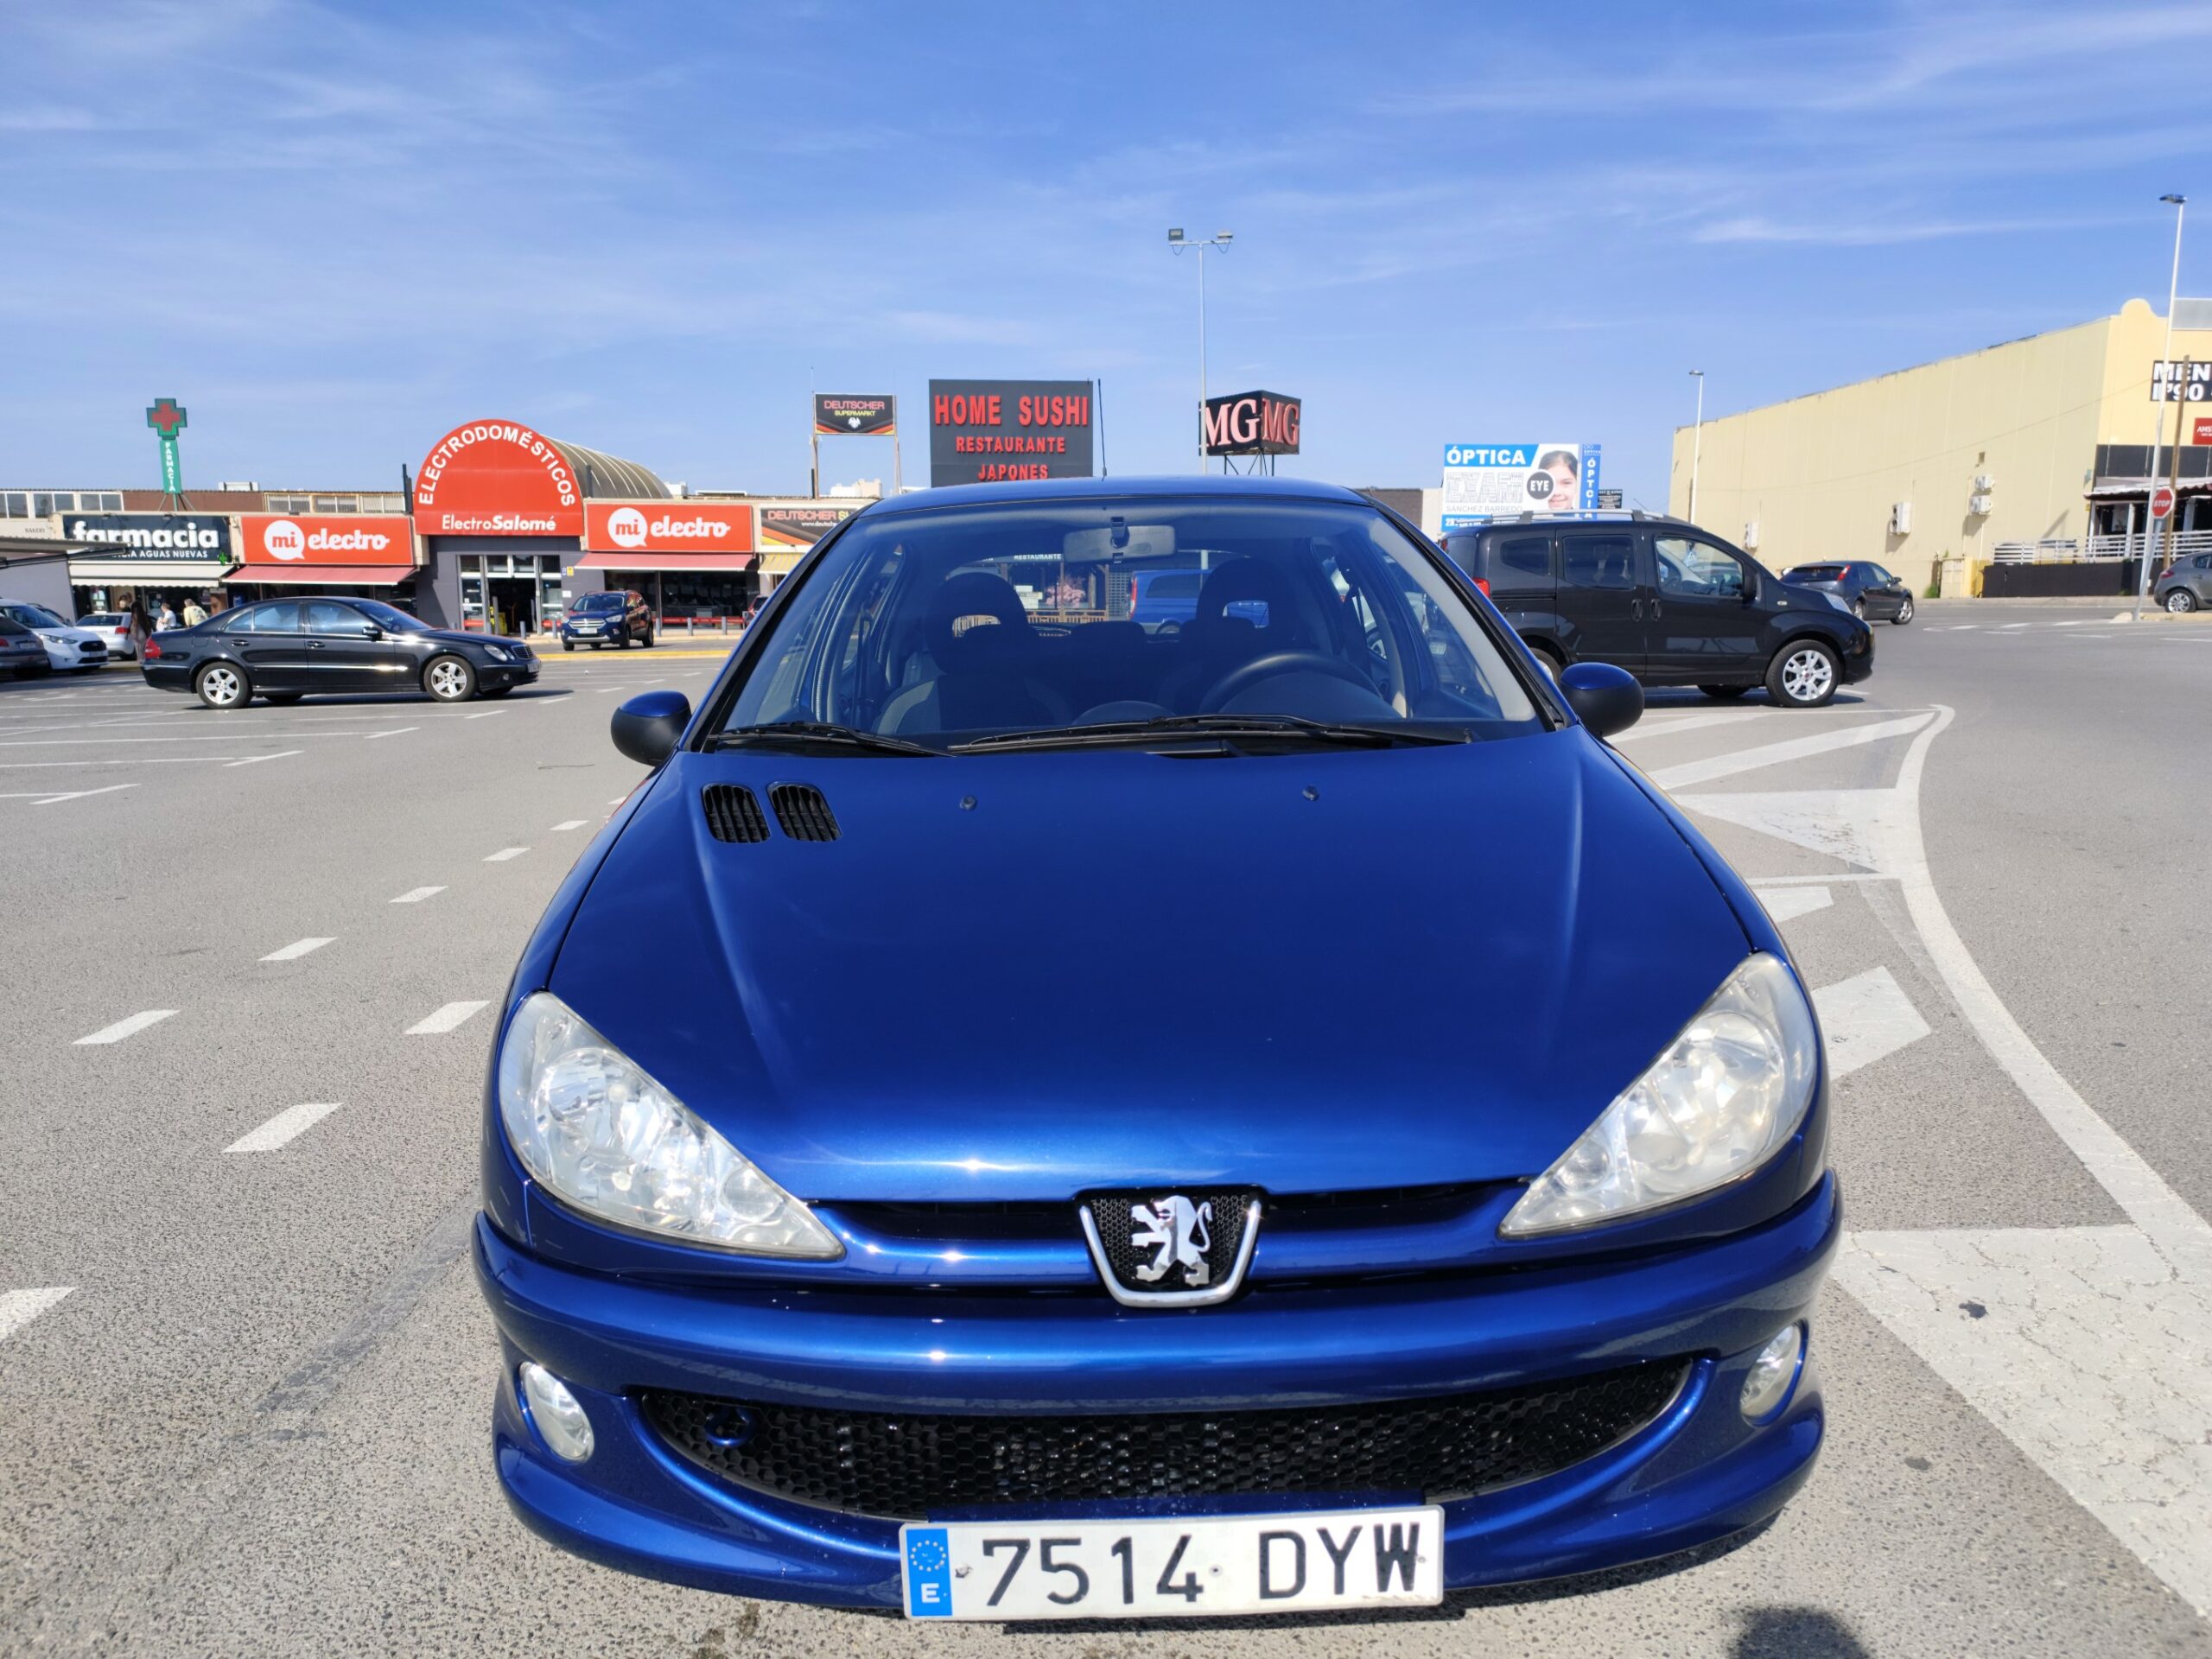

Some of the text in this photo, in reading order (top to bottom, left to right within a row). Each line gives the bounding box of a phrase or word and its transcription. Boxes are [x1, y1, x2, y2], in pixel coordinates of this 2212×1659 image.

[823, 400, 885, 410] DEUTSCHER
[935, 395, 1088, 426] HOME SUSHI
[1199, 398, 1260, 447] MG
[1262, 397, 1300, 446] MG
[956, 436, 1065, 453] RESTAURANTE
[418, 424, 575, 506] ELECTRODOMÉSTICOS
[1446, 446, 1526, 465] ÓPTICA
[164, 442, 176, 492] FARMACIA
[978, 464, 1048, 480] JAPONES
[1530, 480, 1550, 492] EYE
[767, 510, 836, 520] DEUTSCHER
[1446, 504, 1483, 512] SÁNCHEZ
[442, 514, 556, 531] ElectroSalomé
[615, 516, 731, 537] mi electro
[73, 520, 220, 548] farmacia
[272, 527, 391, 550] mi electro
[982, 1522, 1420, 1606] 7514 DYW
[921, 1583, 940, 1603] E
